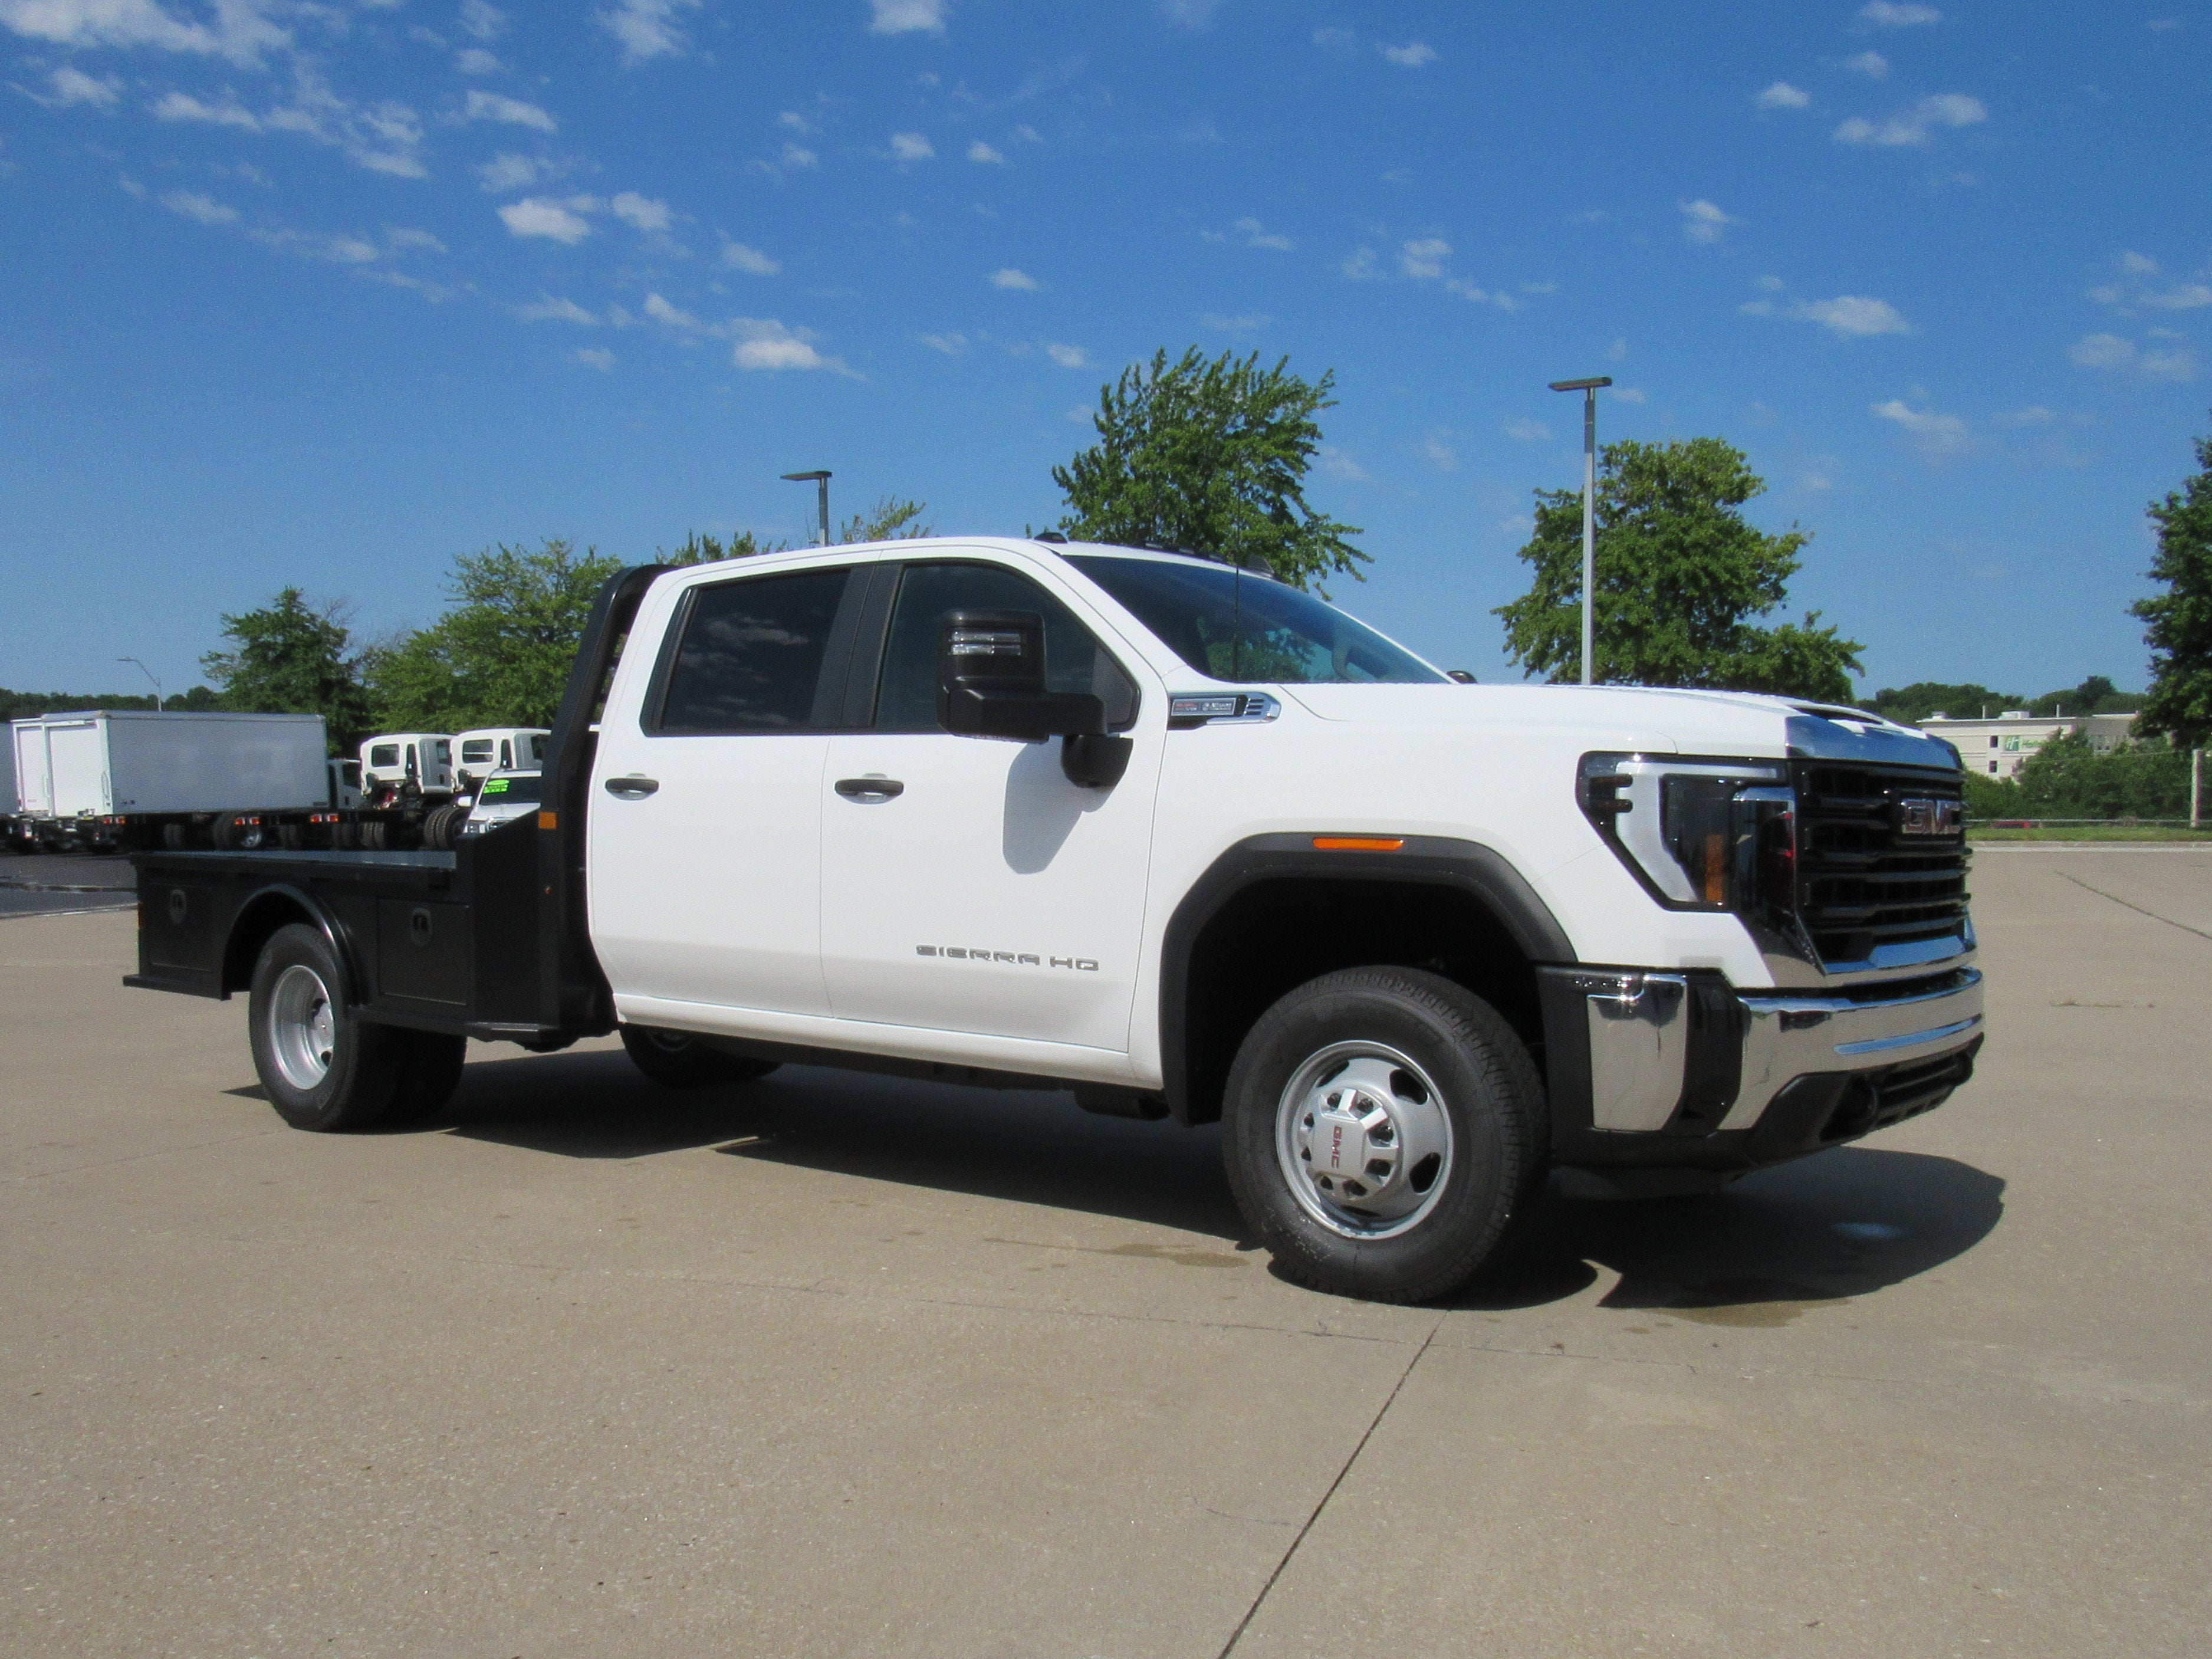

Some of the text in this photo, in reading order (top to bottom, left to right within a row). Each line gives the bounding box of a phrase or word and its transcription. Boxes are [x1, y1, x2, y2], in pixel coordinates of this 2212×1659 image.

[916, 944, 1099, 971] SIERRA HD
[1331, 1126, 1342, 1168] GMC
